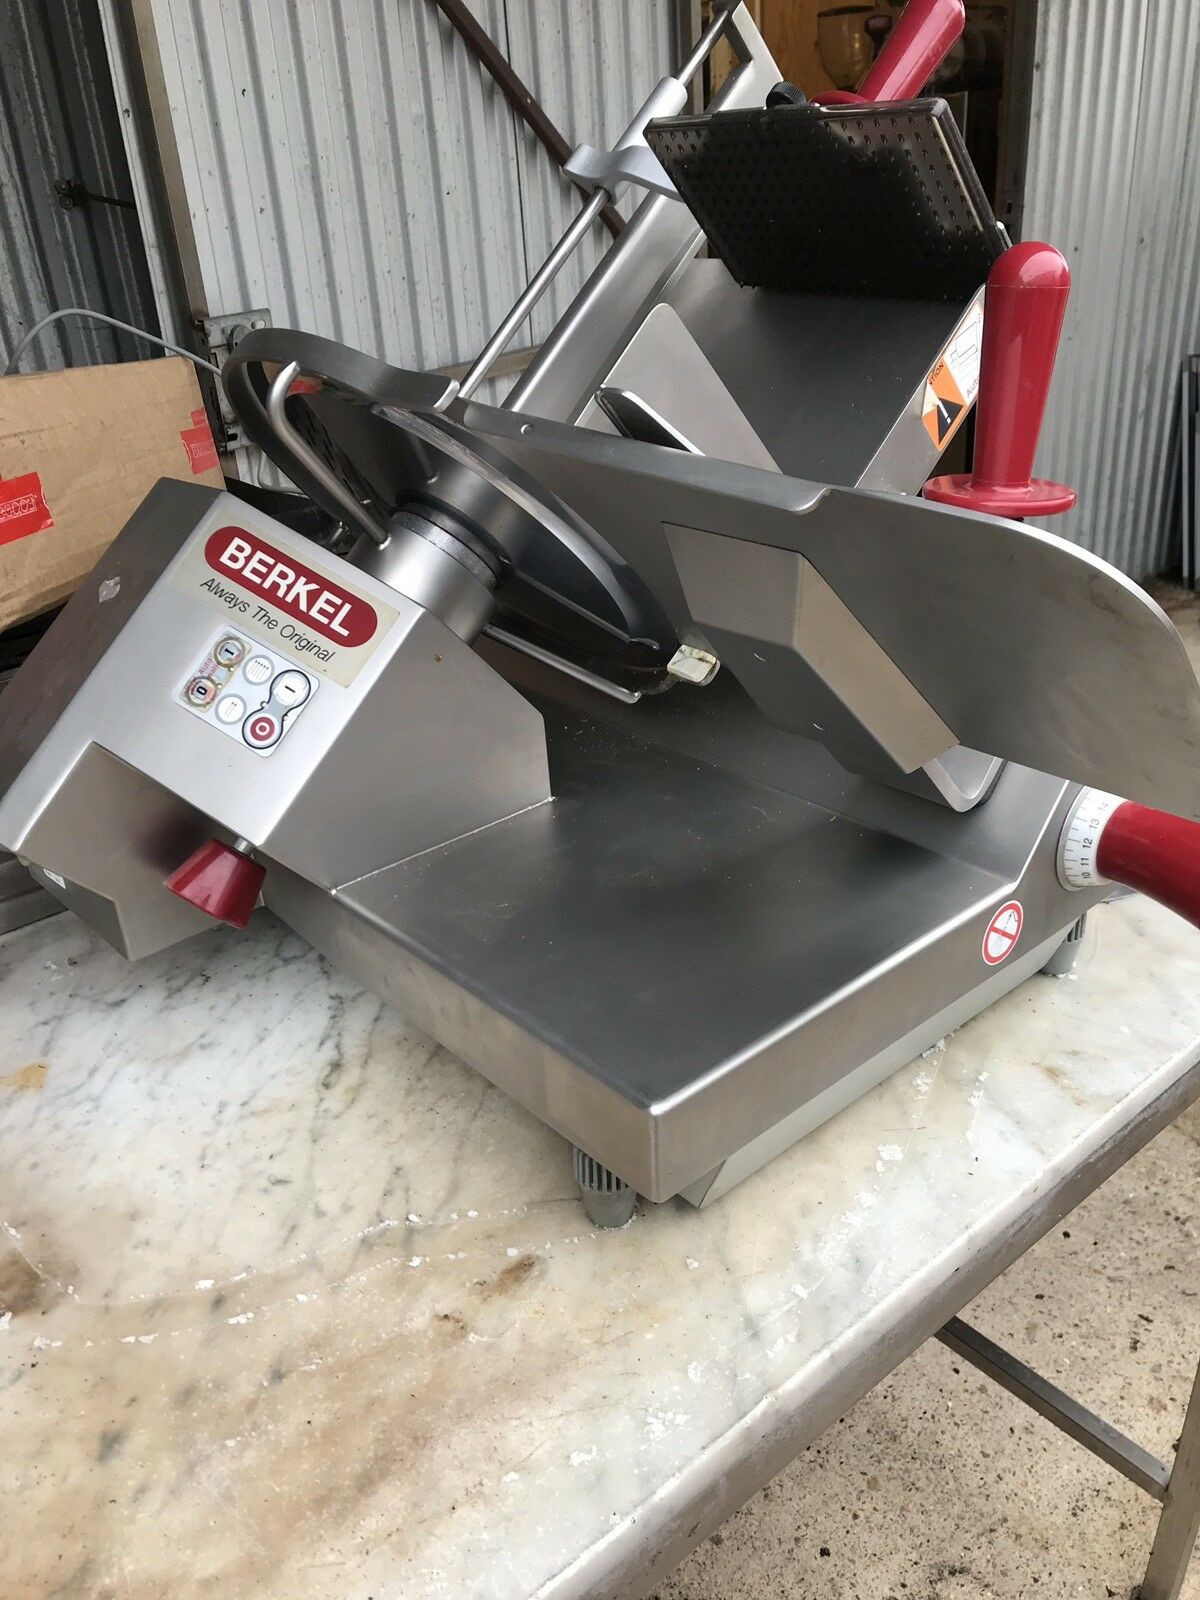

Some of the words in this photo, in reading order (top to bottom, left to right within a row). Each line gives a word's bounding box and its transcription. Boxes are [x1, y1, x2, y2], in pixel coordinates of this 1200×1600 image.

[219, 536, 353, 637] BERKEL
[200, 578, 250, 612] Always
[252, 606, 279, 630] The
[280, 624, 336, 663] Original
[1089, 818, 1100, 830] 13
[1082, 837, 1093, 849] 12
[1080, 857, 1090, 866] 11
[1081, 871, 1091, 879] 10
